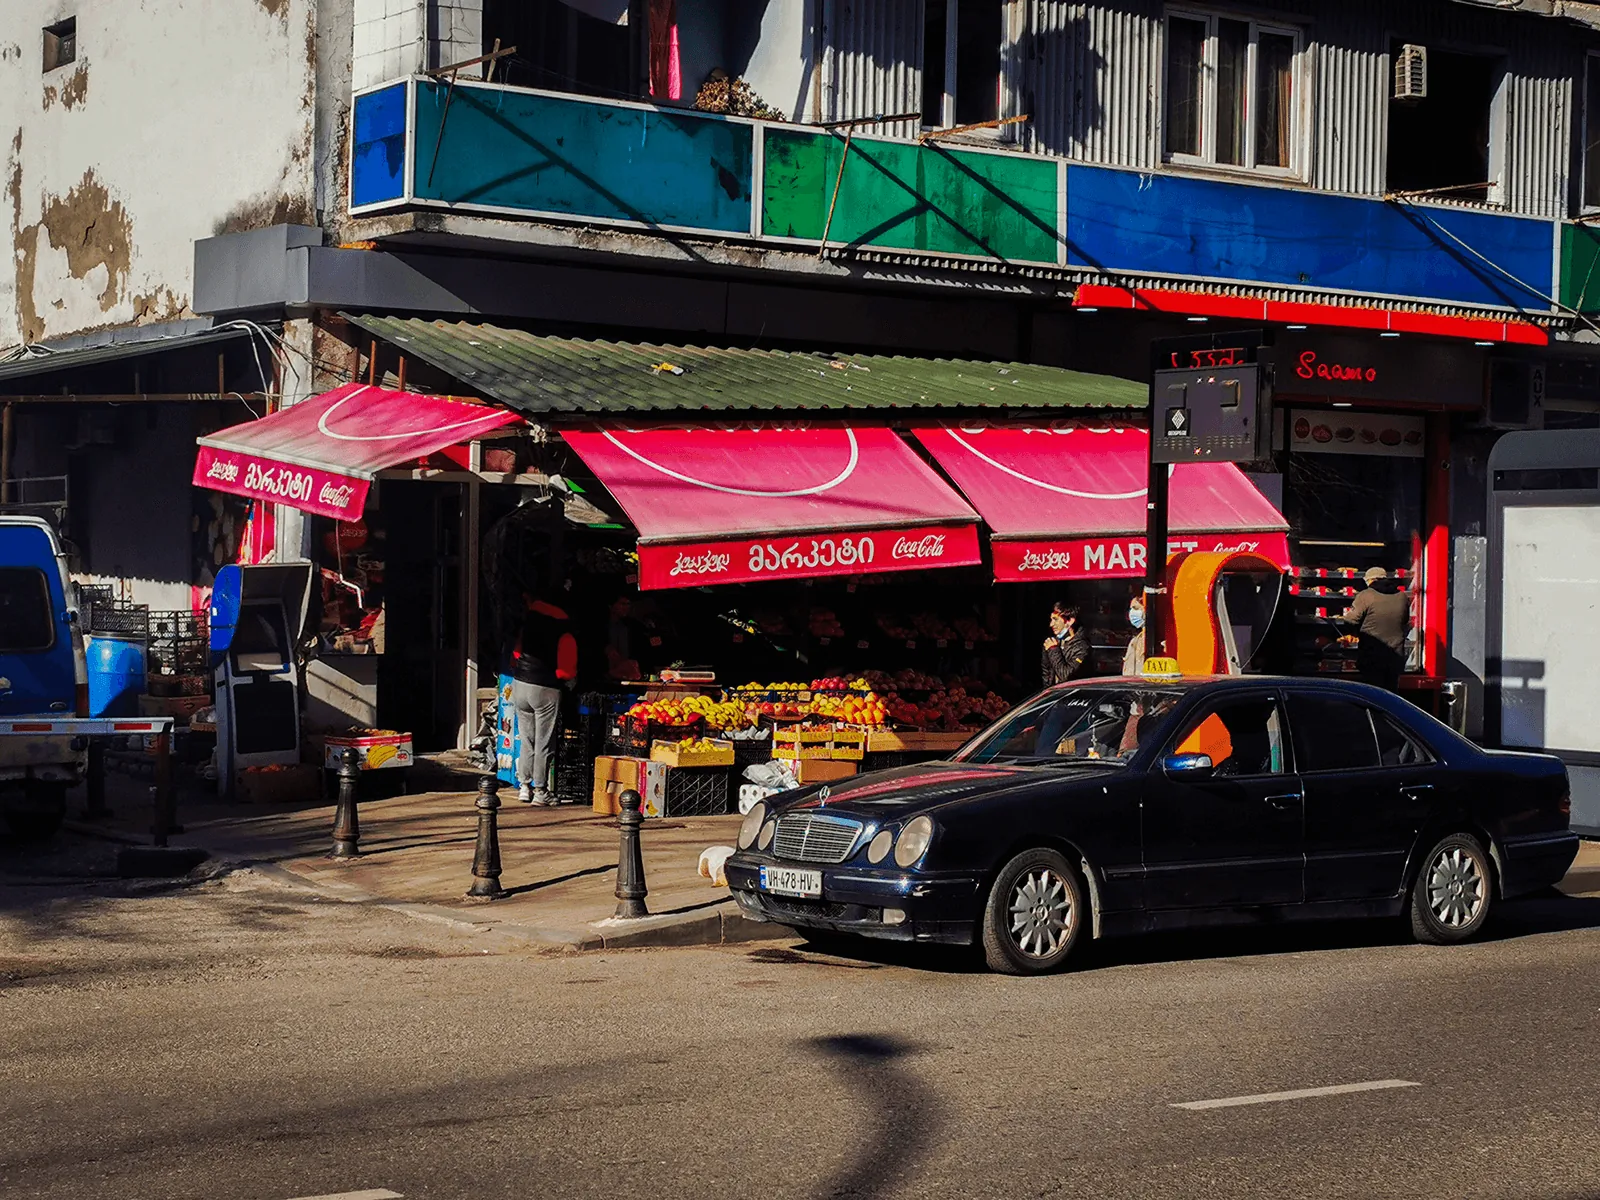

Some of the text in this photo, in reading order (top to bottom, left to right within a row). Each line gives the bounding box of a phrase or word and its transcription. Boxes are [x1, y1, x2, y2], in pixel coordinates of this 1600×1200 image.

[1296, 350, 1377, 382] Saamo
[1533, 369, 1543, 407] AUX
[244, 463, 313, 502] მარკეტი
[748, 536, 875, 573] მარკეტი
[891, 534, 946, 559] Coca-Cola
[1083, 541, 1199, 571] MART
[1146, 660, 1168, 672] TAXI
[767, 870, 813, 891] VH-478-HV
